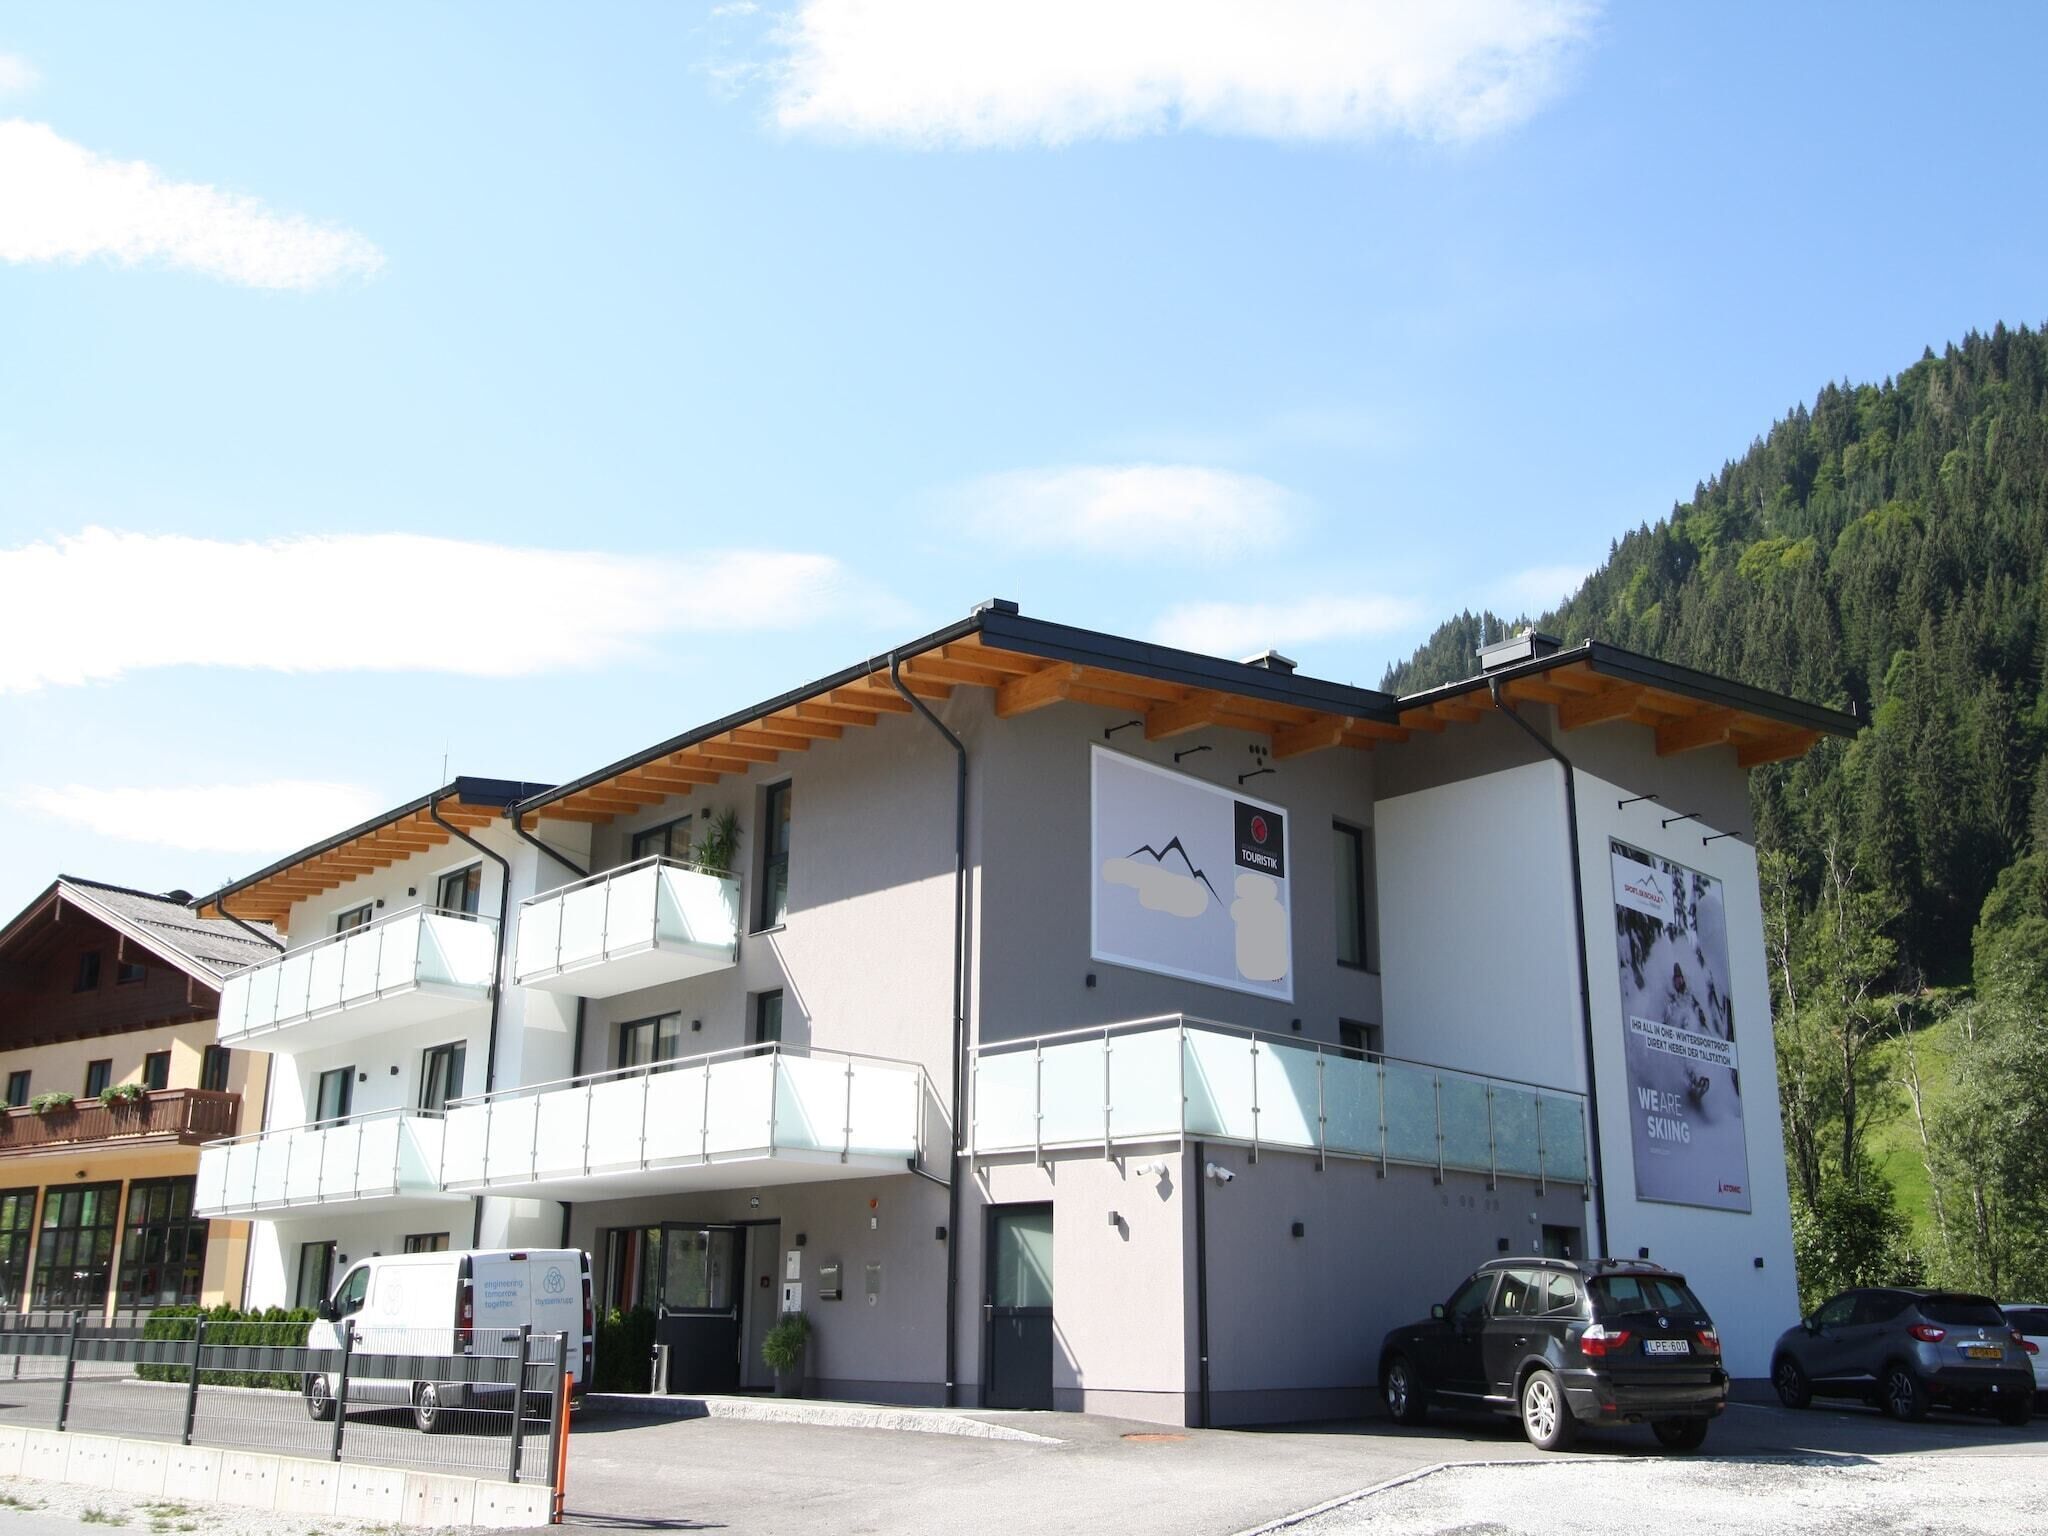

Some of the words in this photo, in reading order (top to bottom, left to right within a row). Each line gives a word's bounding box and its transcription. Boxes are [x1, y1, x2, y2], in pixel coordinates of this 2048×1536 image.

[1241, 848, 1278, 869] TOURISTIK
[1631, 1018, 1642, 1029] IHR
[1642, 1022, 1654, 1034] ALL
[1653, 1025, 1661, 1037] IN
[1675, 1032, 1730, 1054] WINTERSPORTPROFI
[1647, 1037, 1667, 1050] DIREKT
[1668, 1042, 1687, 1056] NEBEN
[1687, 1047, 1698, 1058] DER
[1698, 1049, 1731, 1066] TALSTATION
[1647, 1115, 1690, 1144] SKIING
[484, 1279, 523, 1290] engineering
[1649, 1341, 1687, 1352] LPE-600
